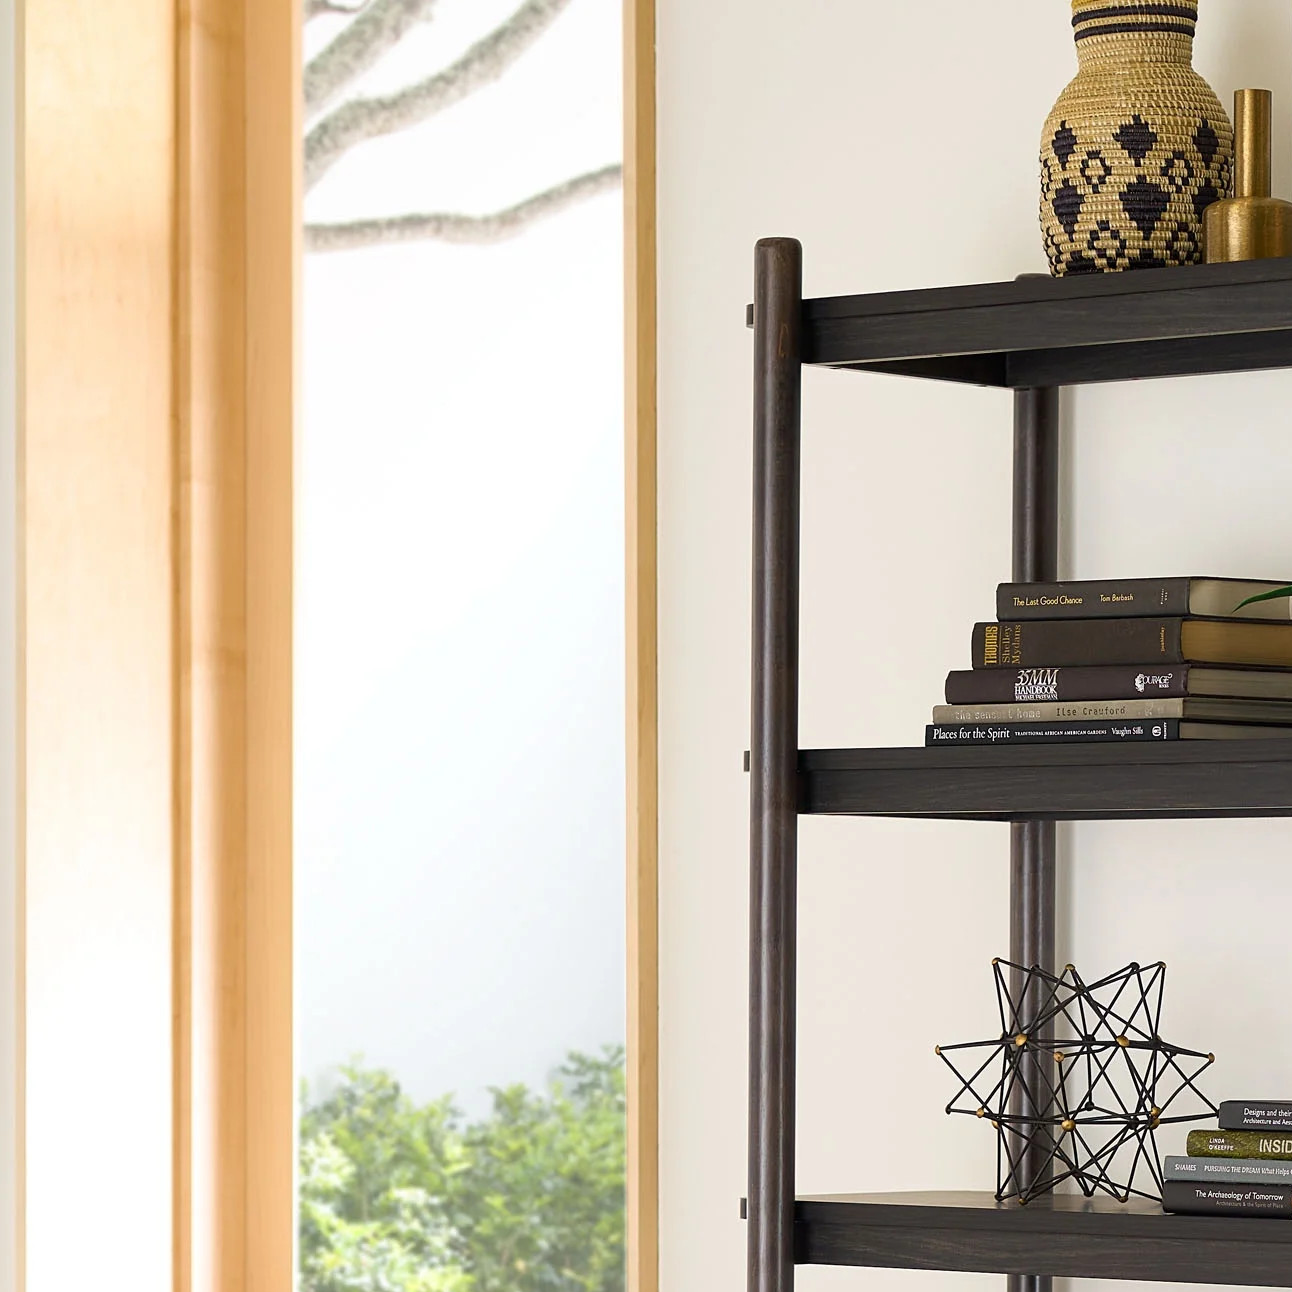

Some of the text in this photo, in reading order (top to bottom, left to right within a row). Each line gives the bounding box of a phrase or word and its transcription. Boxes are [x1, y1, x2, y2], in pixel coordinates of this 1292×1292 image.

[1013, 596, 1083, 606] The Last Good Chance
[984, 626, 998, 665] THOMAS
[1002, 626, 1012, 663] Shelley
[1012, 624, 1022, 664] Mydans
[1015, 670, 1060, 686] 35MM
[1014, 685, 1058, 695] HANDBOOK
[1016, 708, 1040, 718] home
[1056, 708, 1076, 716] Ilse
[933, 727, 1010, 741] Places for the Spirit
[1112, 726, 1144, 737] Vaughn Sills
[1244, 1108, 1266, 1116] Designs
[1266, 1108, 1277, 1116] and
[1278, 1108, 1292, 1116] their
[1174, 1164, 1196, 1172] SHAMES
[1276, 1168, 1289, 1176] Helps
[1195, 1190, 1207, 1198] The
[1208, 1190, 1243, 1201] Archaeology
[1252, 1192, 1284, 1200] Tomorrow
